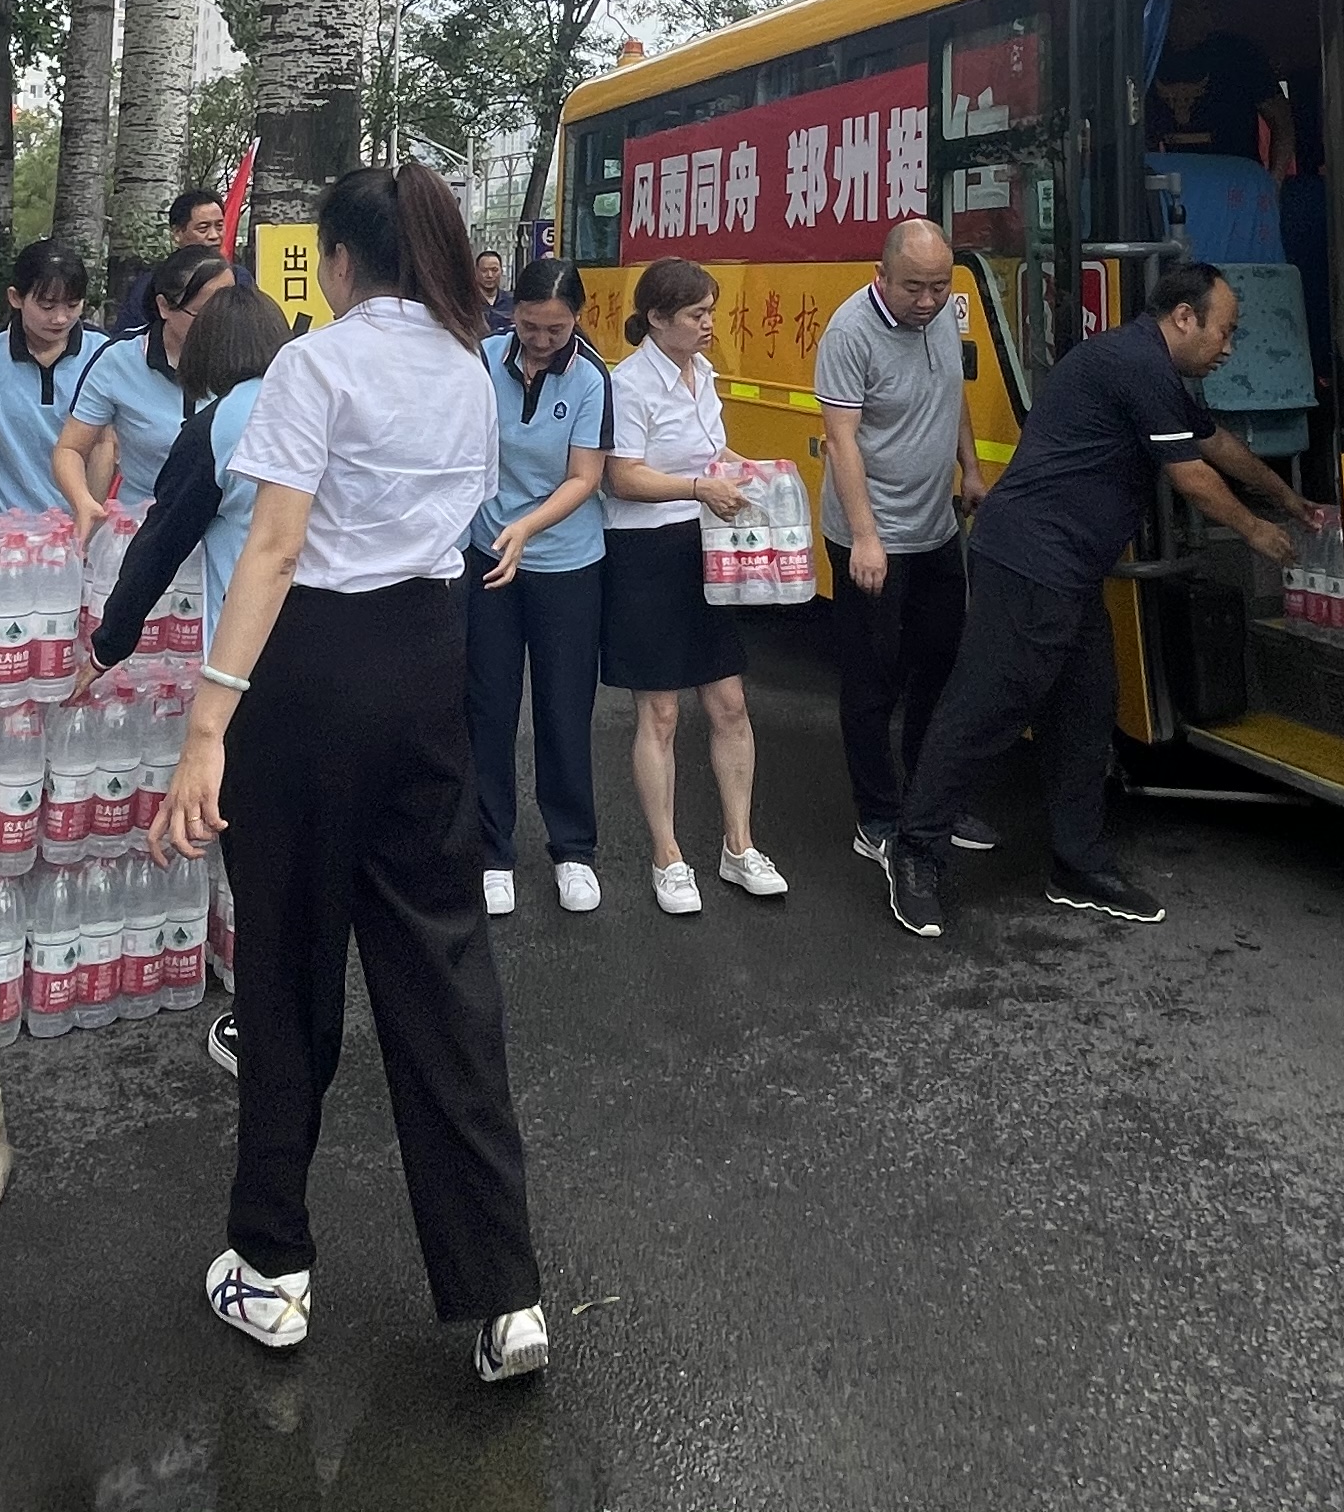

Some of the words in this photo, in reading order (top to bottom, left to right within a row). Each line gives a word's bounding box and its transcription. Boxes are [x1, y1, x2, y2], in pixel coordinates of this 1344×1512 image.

[629, 141, 760, 238] 风雨同舟
[284, 245, 308, 302] 出口
